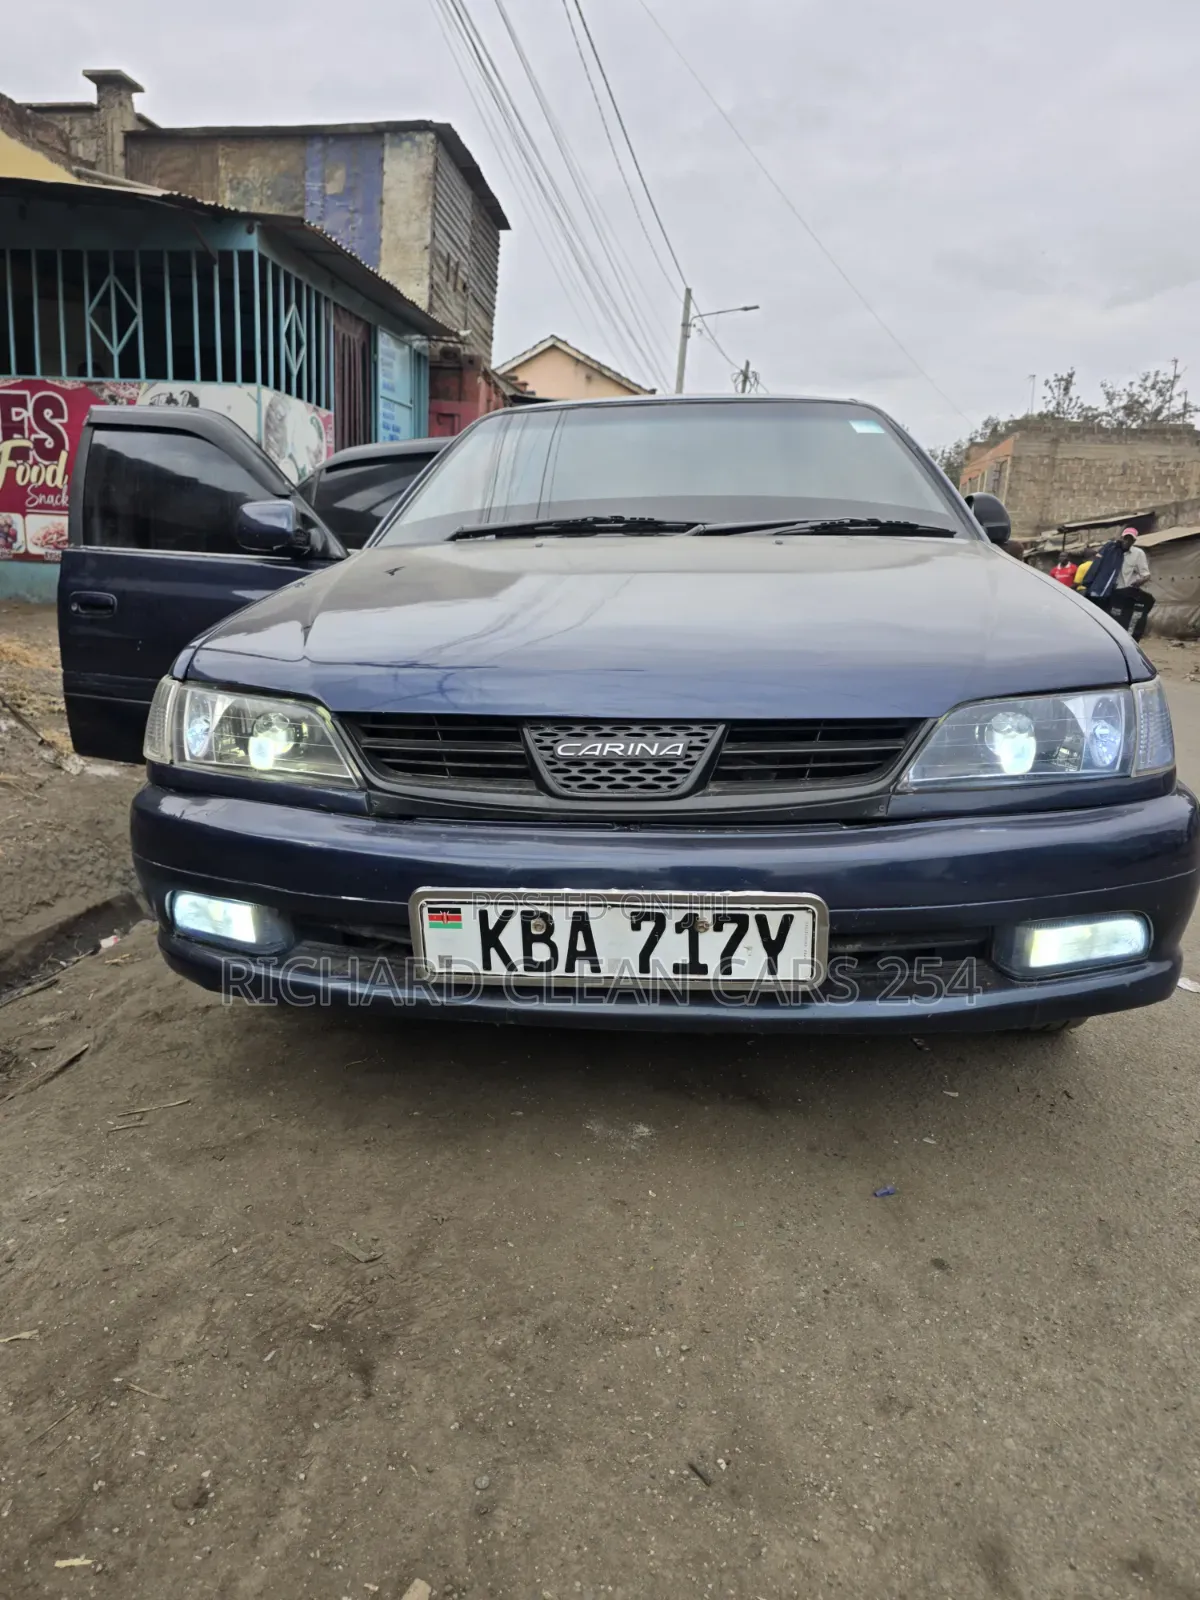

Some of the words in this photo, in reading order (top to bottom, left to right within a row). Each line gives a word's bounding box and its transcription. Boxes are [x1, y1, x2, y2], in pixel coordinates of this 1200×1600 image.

[0, 439, 68, 490] Food
[557, 742, 684, 757] CARINA
[477, 909, 602, 973] KBA
[630, 912, 795, 976] 717Y
